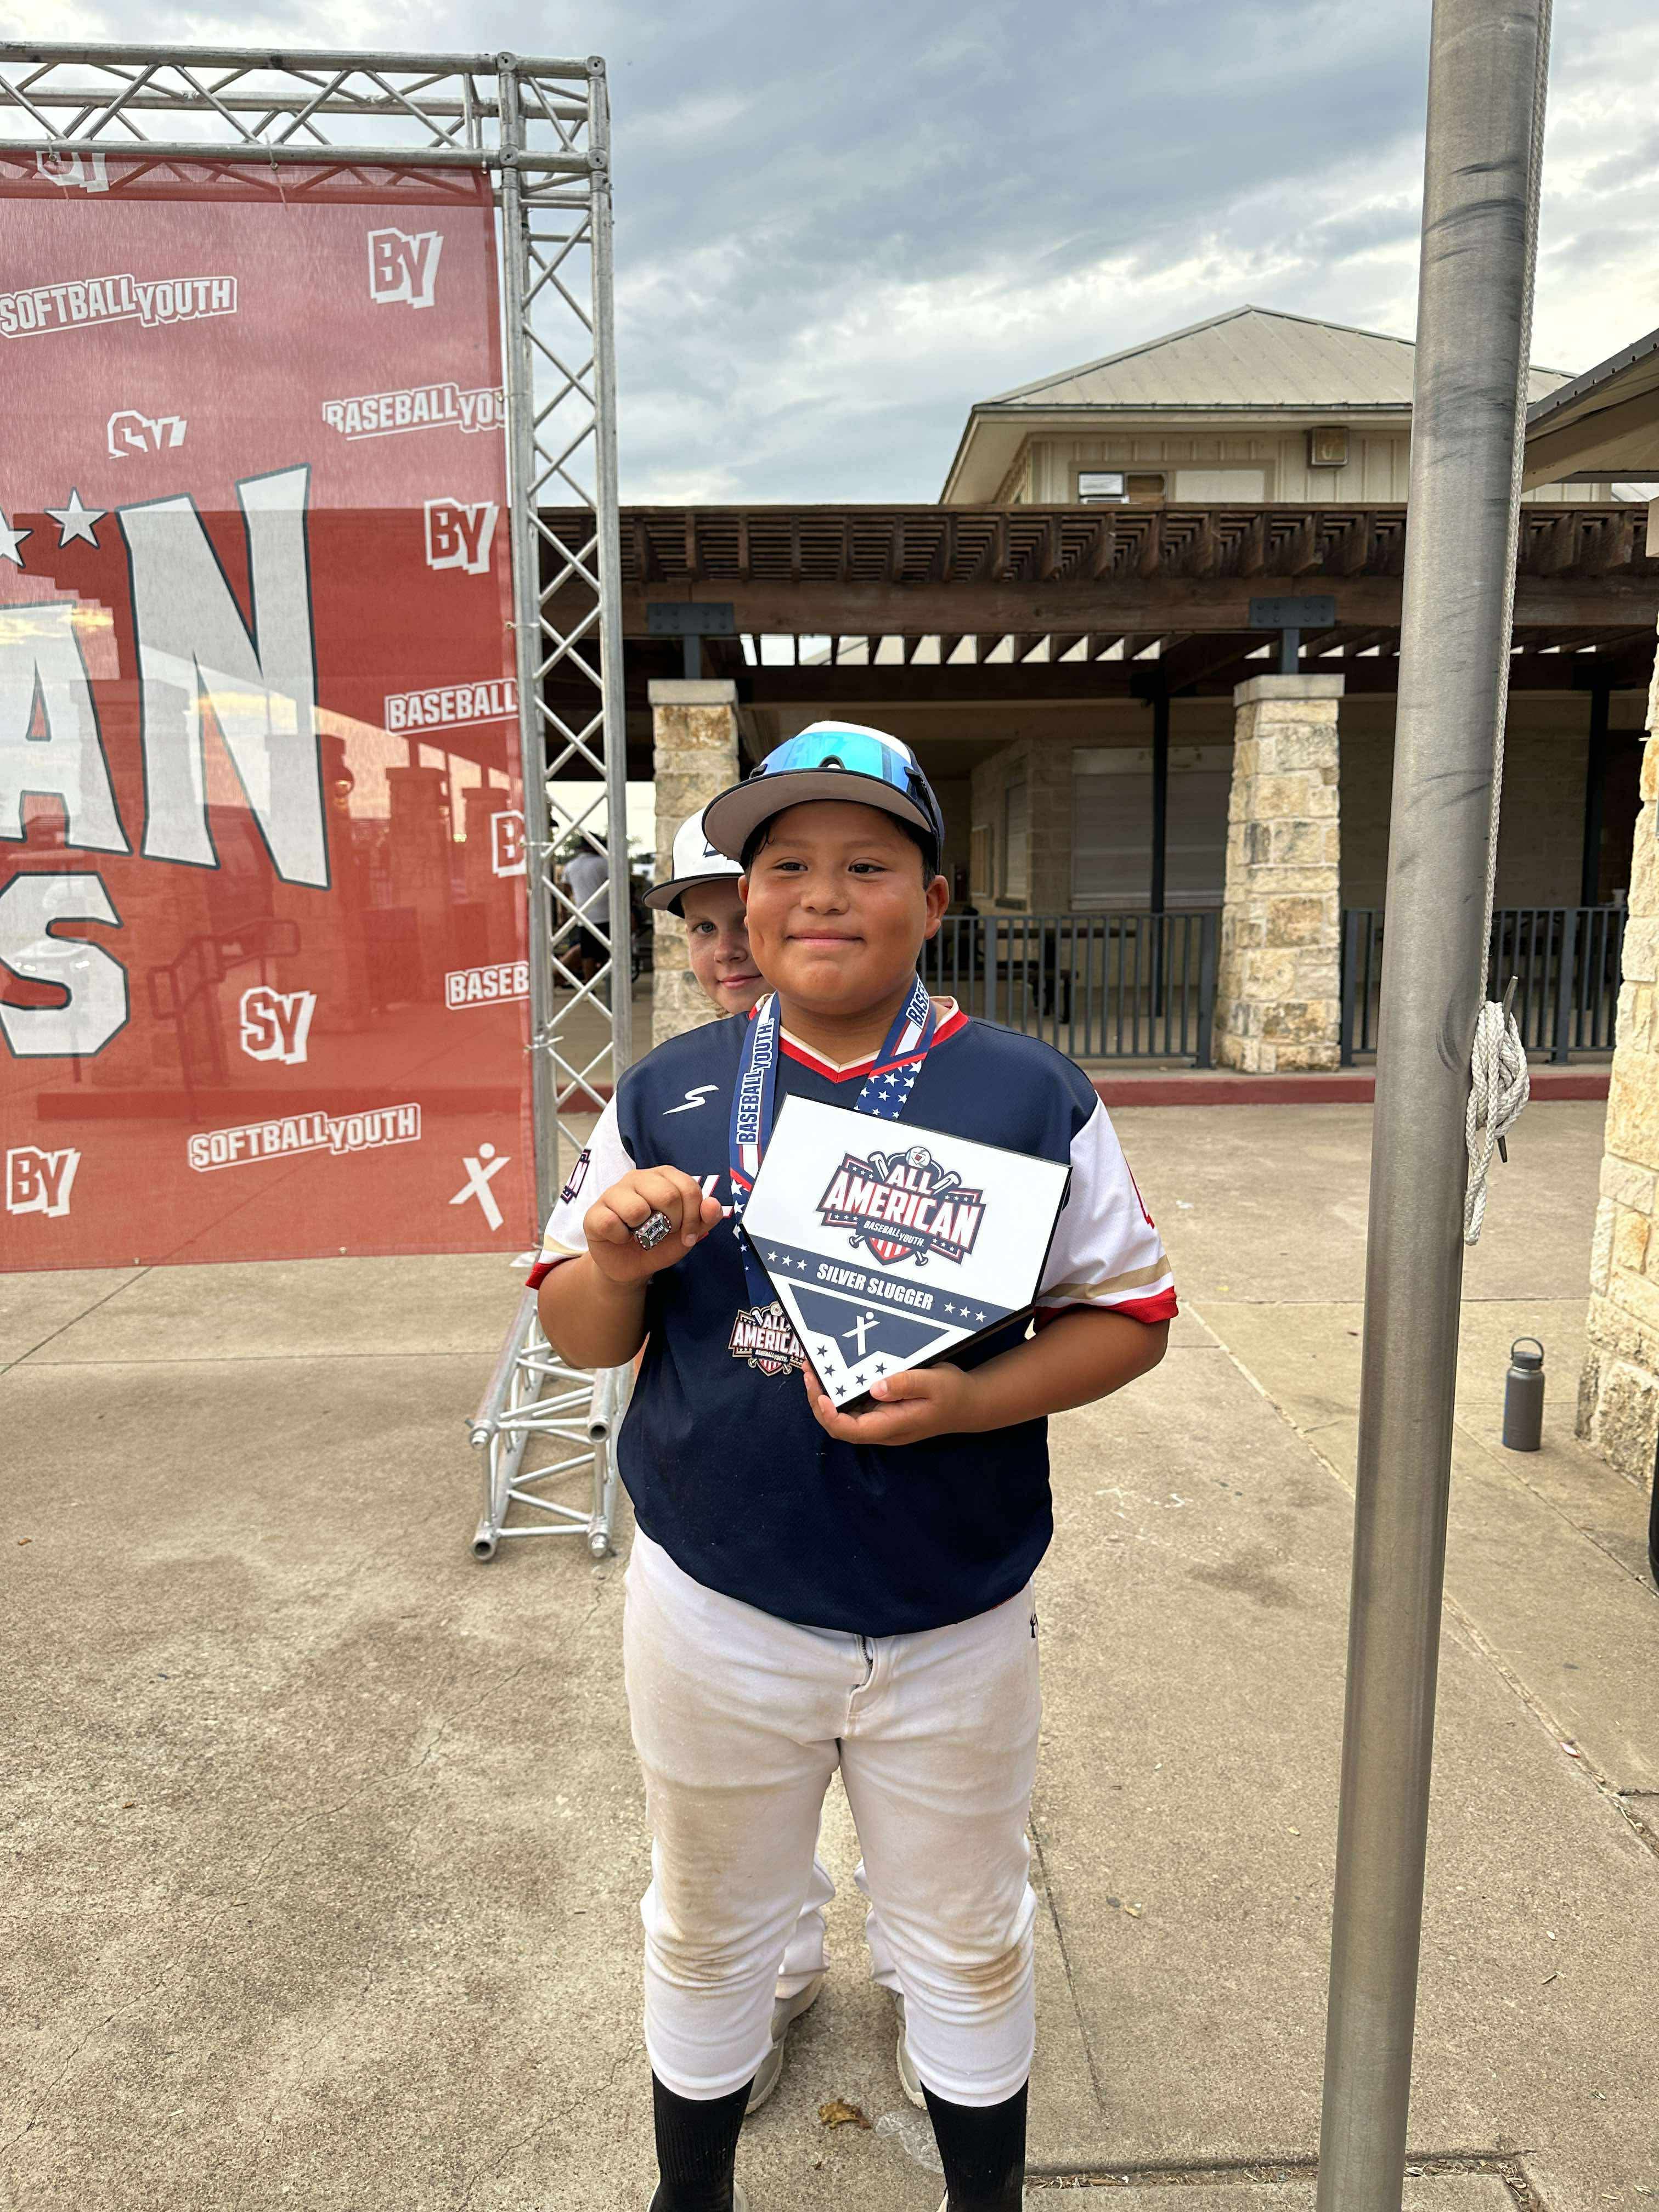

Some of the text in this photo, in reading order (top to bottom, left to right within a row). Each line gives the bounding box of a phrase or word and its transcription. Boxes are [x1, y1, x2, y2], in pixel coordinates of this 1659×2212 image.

[370, 229, 439, 304] BY
[426, 498, 496, 572] BY
[242, 987, 313, 1062] SY
[8, 1146, 78, 1215] BY
[822, 1169, 981, 1248] AMERICAN
[886, 1164, 933, 1195] ALL
[816, 1263, 934, 1311] SILVER SLUGGER
[763, 1314, 788, 1332] ALL
